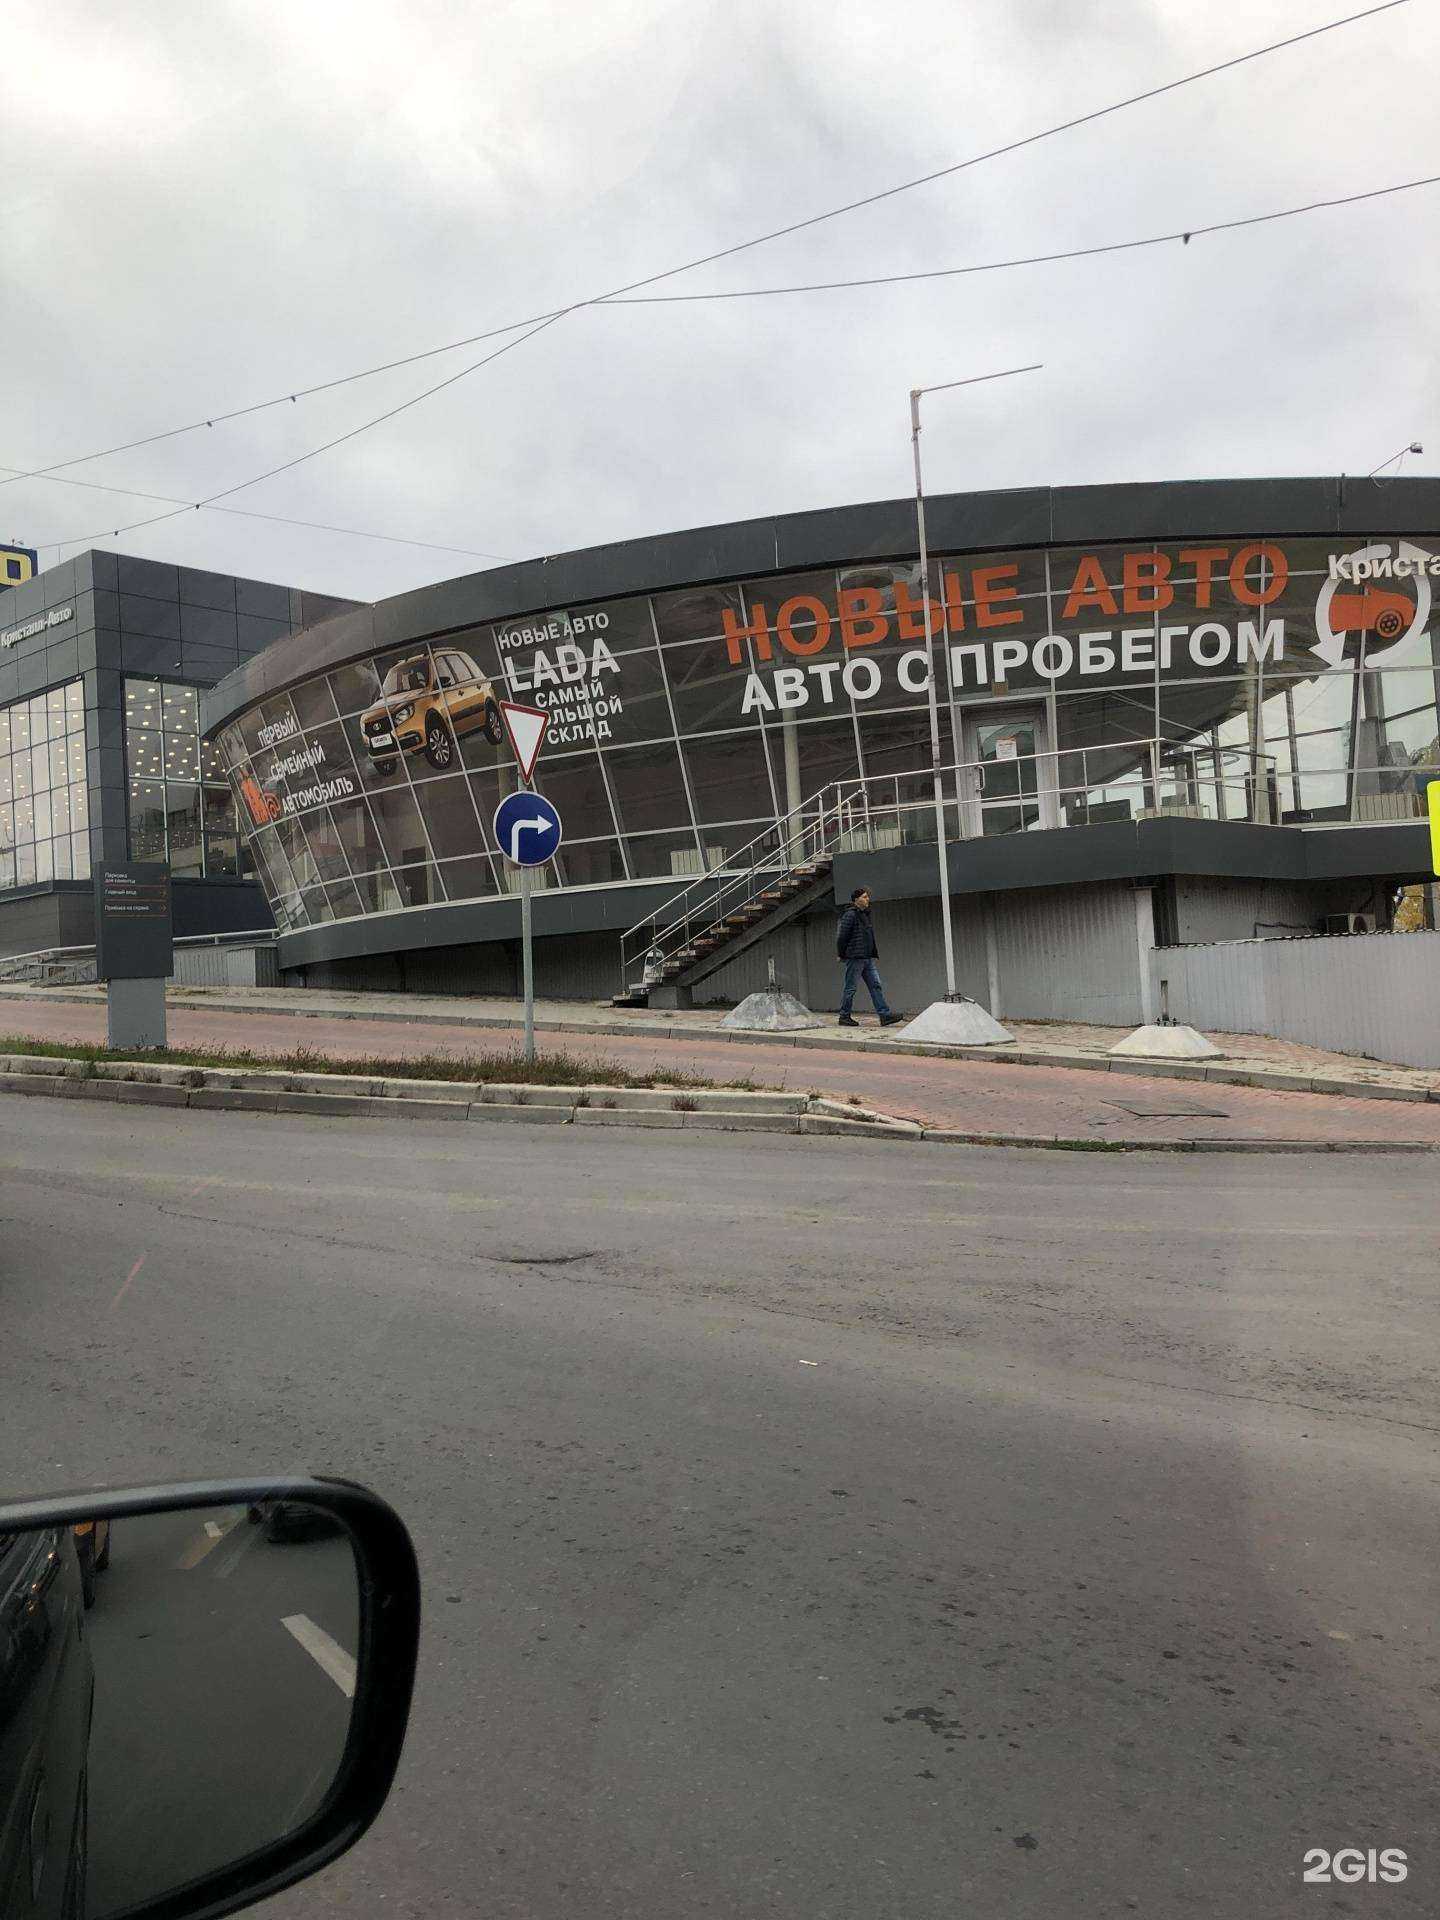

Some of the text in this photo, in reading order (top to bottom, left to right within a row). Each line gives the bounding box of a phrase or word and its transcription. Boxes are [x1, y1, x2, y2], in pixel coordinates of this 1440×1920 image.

[721, 543, 1289, 665] НОВЫЕ АВТО
[498, 612, 609, 650] НОВЫЕ АВТО
[504, 637, 621, 693] LADA
[741, 618, 1285, 715] АВТО С ПРОБЕГОМ
[535, 678, 605, 709] САМЫЙ
[548, 694, 623, 726] ЛЬШОЙ
[257, 710, 298, 747] ПЕРВЫЙ
[547, 720, 612, 745] СКЛАД
[270, 739, 326, 780] СЕМЕЙНЫЙ
[281, 776, 354, 814] АВТОМОБИЛЬ
